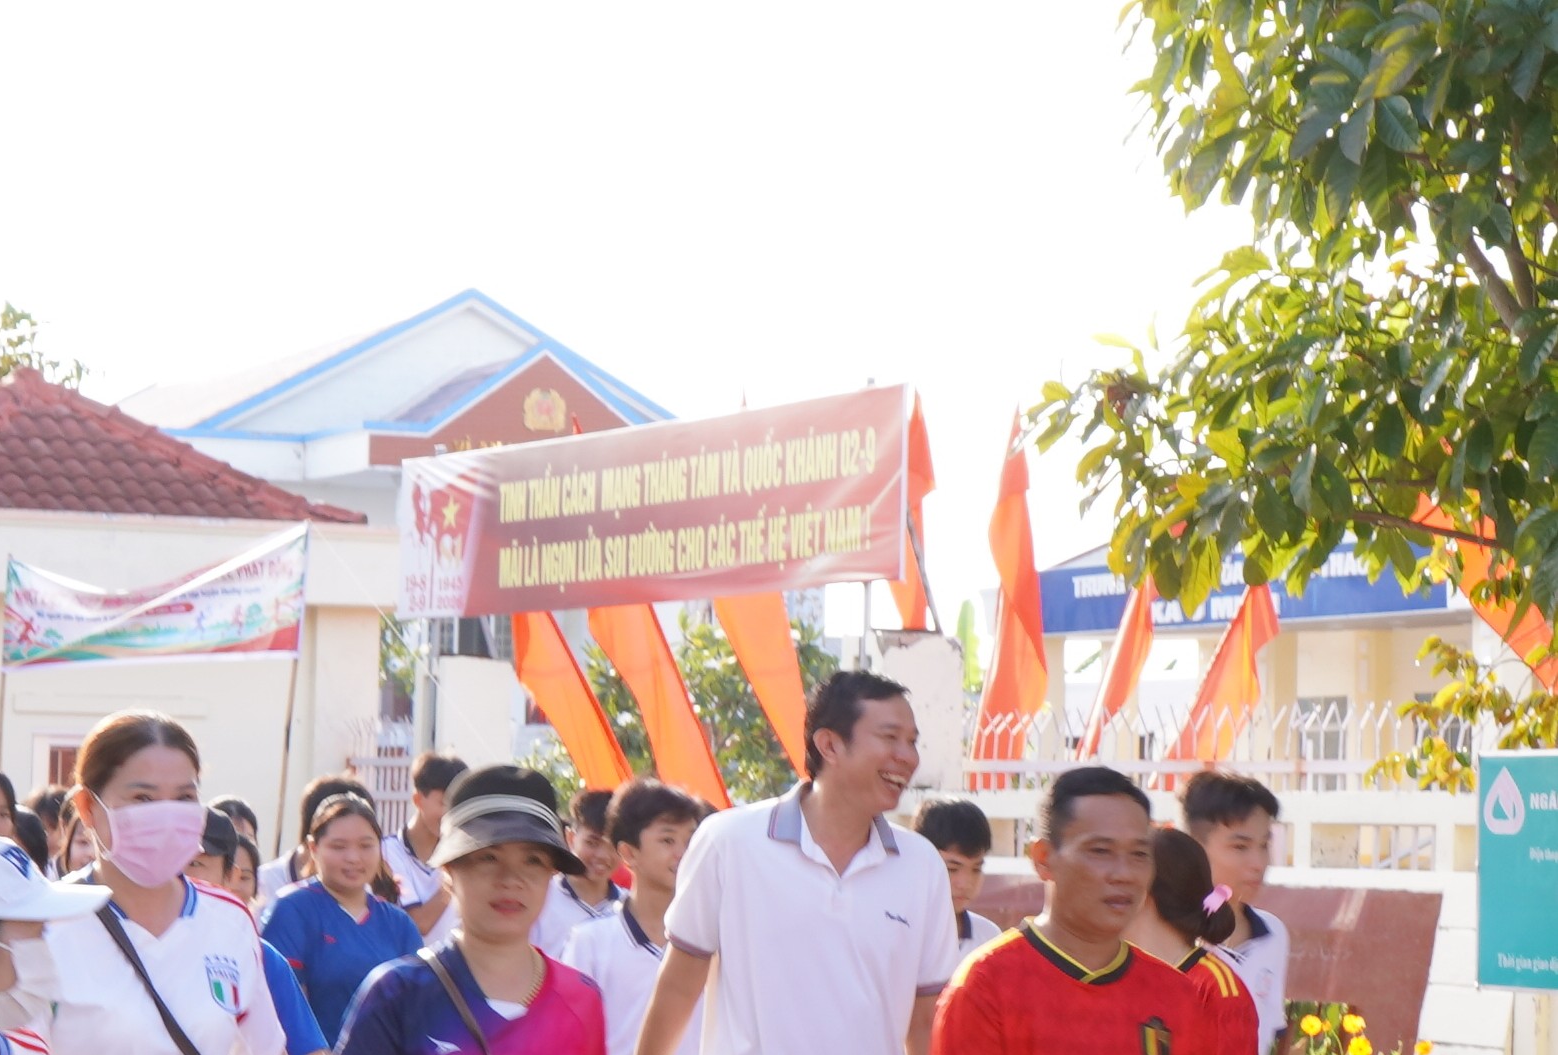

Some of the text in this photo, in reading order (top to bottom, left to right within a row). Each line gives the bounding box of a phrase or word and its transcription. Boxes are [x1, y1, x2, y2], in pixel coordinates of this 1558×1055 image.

[499, 480, 527, 523] TINH
[562, 464, 596, 516] CÁCH
[601, 463, 641, 520] MẠNG
[643, 450, 688, 506] THÁNG
[690, 445, 720, 500] TÁM
[722, 439, 741, 495] VÀ
[743, 427, 782, 497] QUỐC
[785, 426, 838, 486] KHÁNH
[840, 426, 876, 477] 02-9
[524, 536, 540, 587] LÀ
[541, 540, 577, 593] NGỌN
[604, 535, 627, 579] SOI
[628, 520, 675, 577] ĐƯỜNG
[676, 525, 705, 572] CHO
[707, 513, 736, 569] CÁC
[738, 503, 765, 566] THẾ
[767, 506, 787, 571] HỆ
[790, 502, 823, 566] VIỆT
[824, 504, 862, 554] NAM
[1529, 789, 1558, 810] NGÂ
